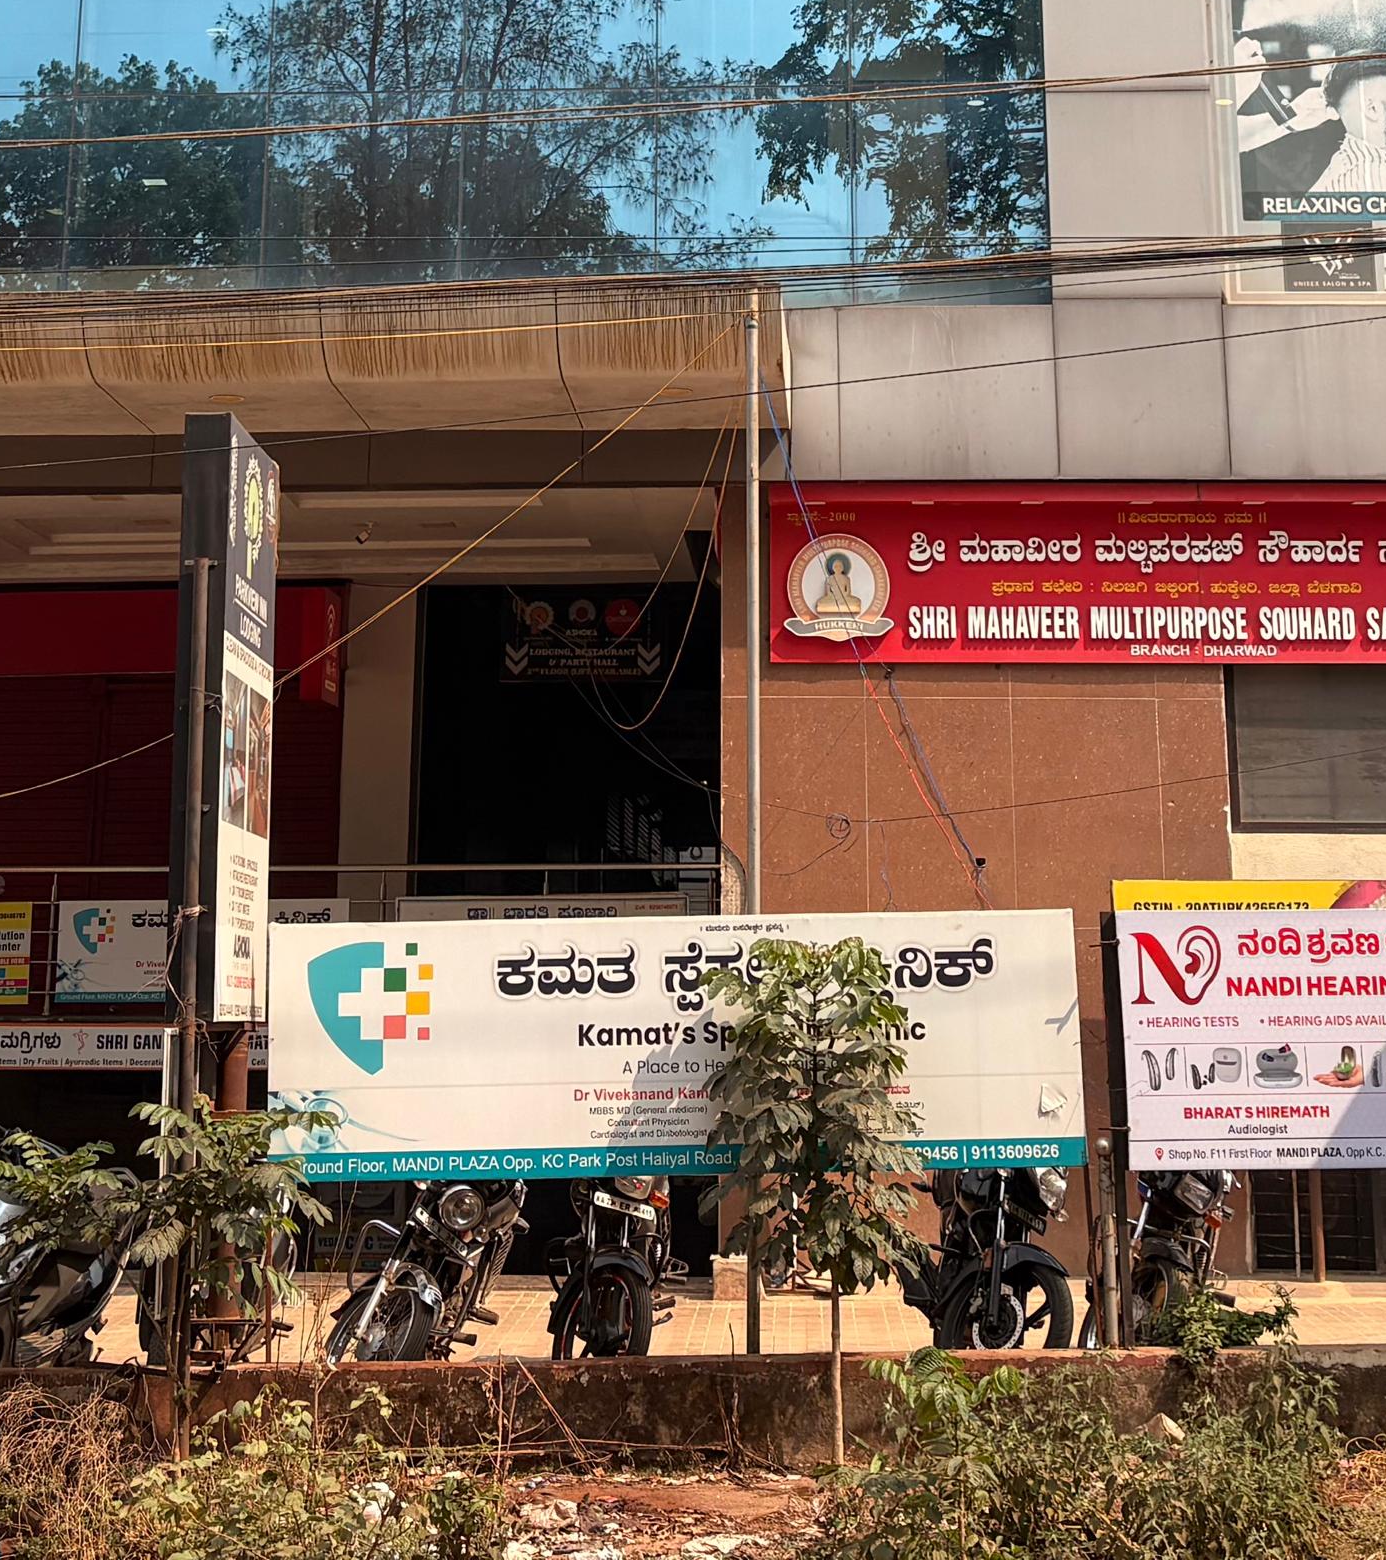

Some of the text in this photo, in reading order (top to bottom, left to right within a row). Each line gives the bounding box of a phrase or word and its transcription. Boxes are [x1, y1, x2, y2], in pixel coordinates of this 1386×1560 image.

[1262, 197, 1363, 214] RELAXING
[908, 531, 946, 572] ಶ್ರೀ
[959, 533, 1081, 562] ಮಹಾವೀರ
[908, 606, 957, 639] SHRI
[967, 605, 1080, 639] MAHAVEER
[1091, 606, 1248, 642] MULTIPURPOSE
[1259, 607, 1356, 640] SOUHARD
[1131, 643, 1279, 657] BRANCH DHARWAD
[1237, 926, 1302, 958] ನಂದಿ
[1307, 928, 1380, 964] ಶ್ರವಣ
[496, 945, 638, 996] ಕಮತ
[1226, 976, 1302, 997] NANDI
[1147, 1017, 1201, 1027] HEARING
[1203, 1016, 1239, 1027] TESTS
[1268, 1015, 1322, 1027] HEARING
[1325, 1015, 1353, 1026] AIDS
[96, 1034, 129, 1050] SHRI
[578, 1021, 696, 1047] Kamat's
[622, 1058, 702, 1075] A Place to
[574, 1087, 673, 1102] Dr Vivekanand
[1184, 1106, 1330, 1119] BHARAT HIREMATH
[1228, 1124, 1288, 1135] Audiologist
[971, 1144, 1059, 1161] 9113609626
[392, 1154, 564, 1172] MANDI PLAZA Opp. KC
